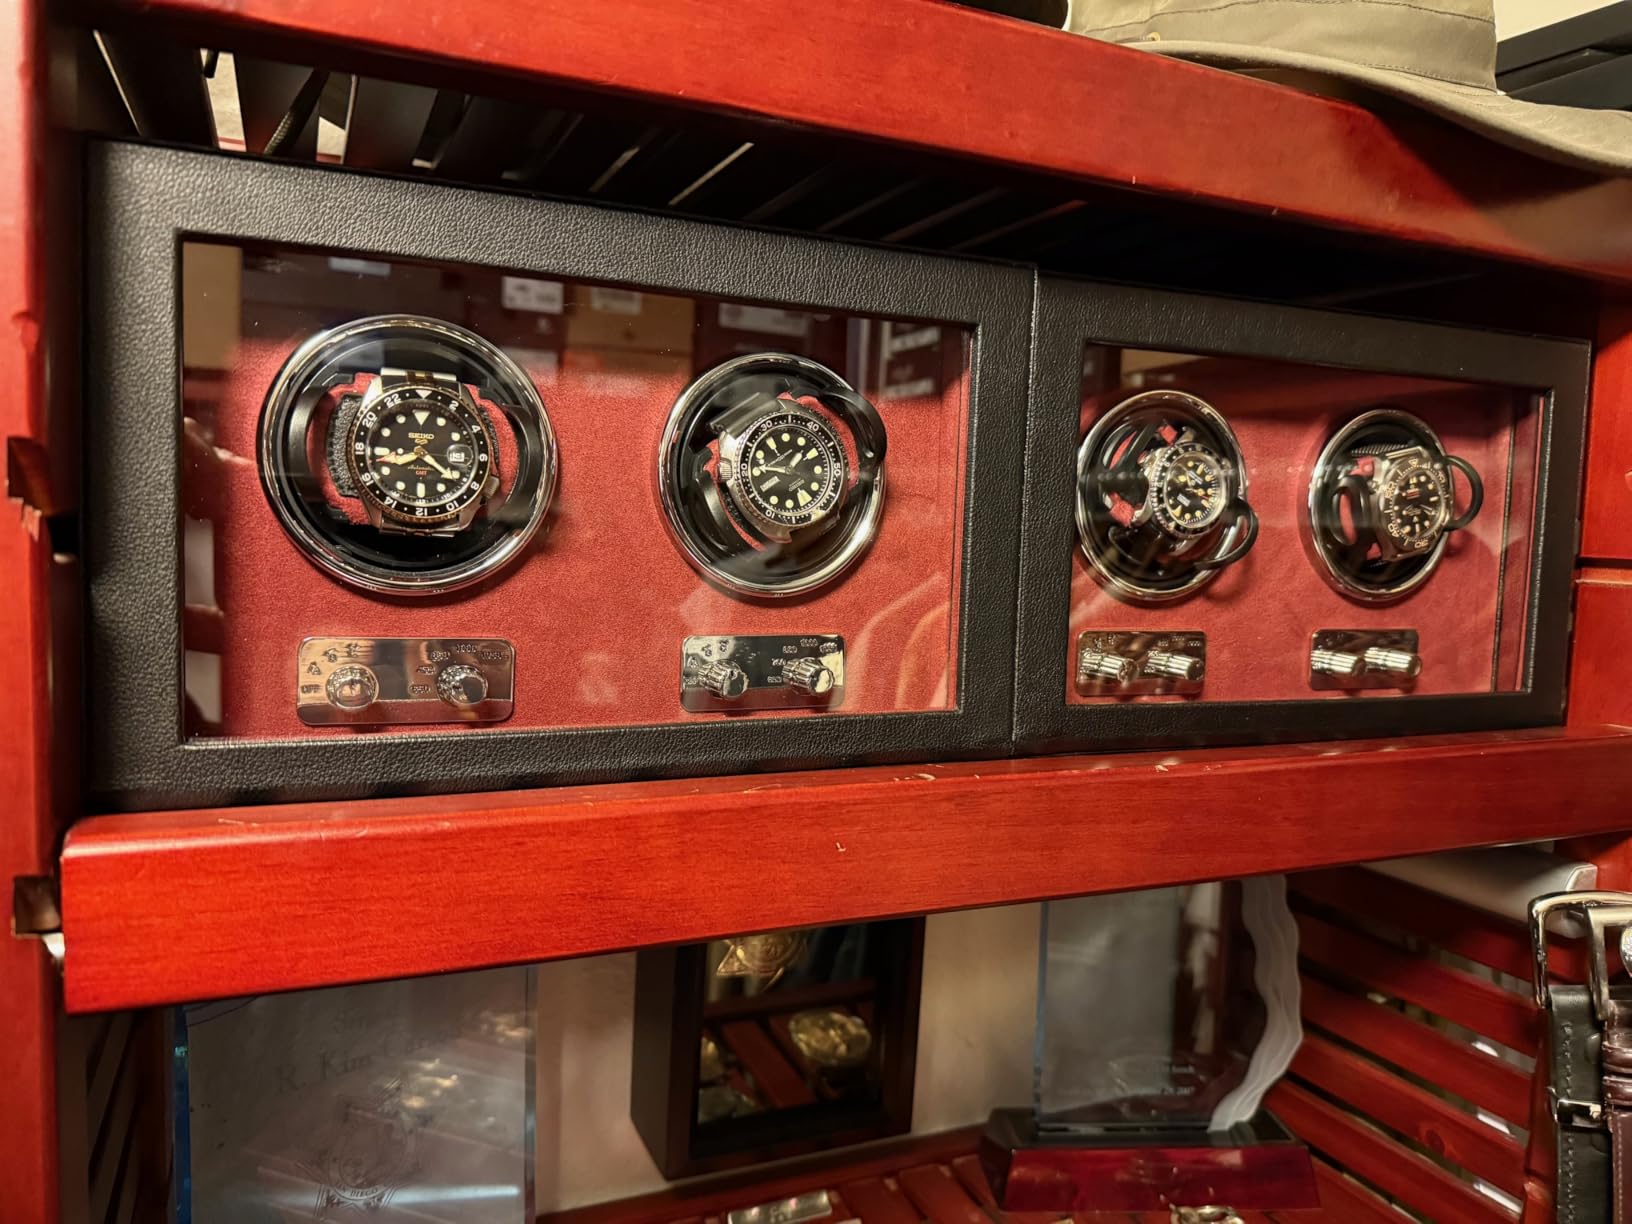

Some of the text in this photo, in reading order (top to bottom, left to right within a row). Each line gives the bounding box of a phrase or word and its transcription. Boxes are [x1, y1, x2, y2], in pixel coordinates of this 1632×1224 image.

[383, 393, 402, 409] 22
[448, 400, 460, 412] 2
[362, 411, 378, 428] 20
[760, 419, 774, 432] 30
[471, 424, 481, 434] 4
[806, 421, 820, 432] 40
[408, 432, 435, 441] SEIKO
[354, 442, 365, 455] 18
[479, 453, 488, 462] 6
[740, 463, 749, 478] 20
[833, 462, 842, 477] 50
[361, 472, 374, 486] 16
[470, 481, 480, 491] 8
[383, 496, 398, 509] 14
[445, 500, 460, 512] 10
[415, 507, 428, 517] 12
[765, 509, 776, 519] 10
[1387, 522, 1400, 538] 40
[350, 1186, 379, 1198] DIEGO
